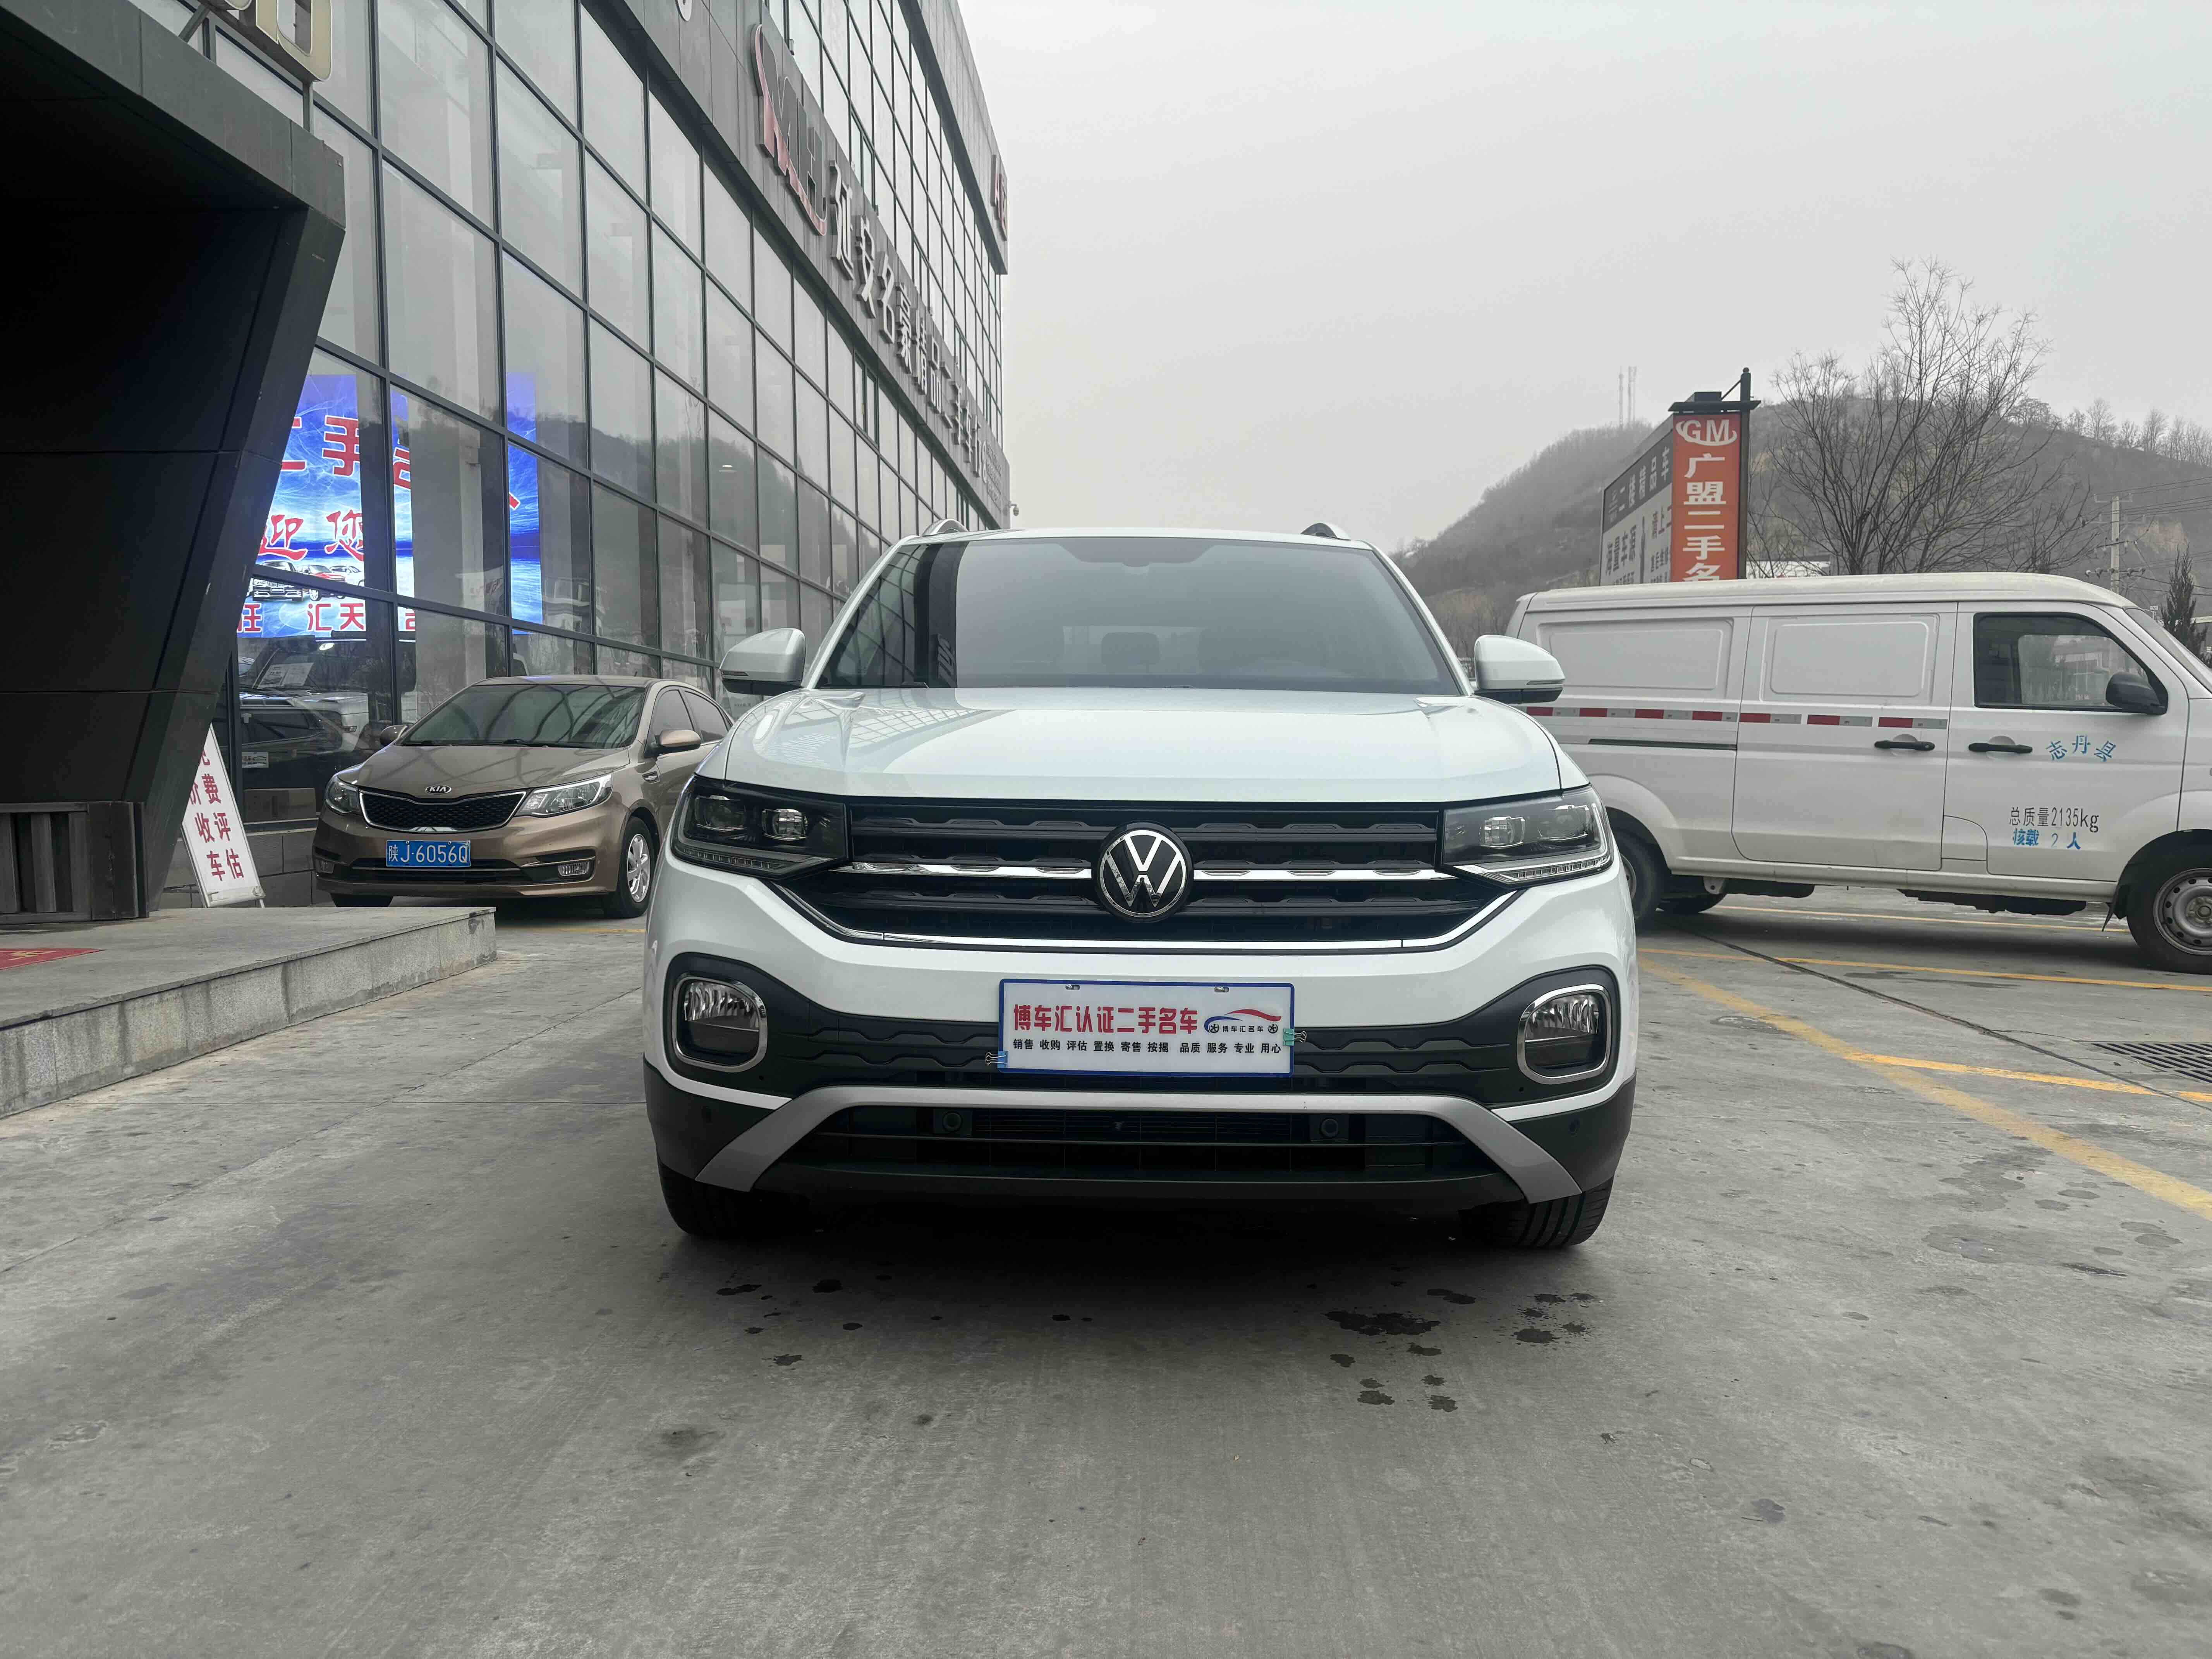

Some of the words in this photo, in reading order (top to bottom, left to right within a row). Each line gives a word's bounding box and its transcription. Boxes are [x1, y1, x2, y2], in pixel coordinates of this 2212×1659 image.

[1684, 419, 1730, 443] GM
[2045, 735, 2116, 762] 志丹县
[2009, 807, 2099, 833] 总质量2135kg
[2066, 832, 2081, 850] 人
[1013, 1004, 1198, 1034] 博车汇认证二手名车
[1013, 1039, 1034, 1049] 销售
[1040, 1039, 1060, 1051] 收购
[1066, 1040, 1087, 1051] 评估
[1094, 1041, 1115, 1052] 置换
[1121, 1041, 1141, 1053] 寄售
[1147, 1042, 1169, 1053] 按揭
[1180, 1042, 1200, 1053] 品质
[1207, 1042, 1228, 1053] 服务
[1234, 1042, 1255, 1053] 专业
[1261, 1043, 1281, 1053] 用心
